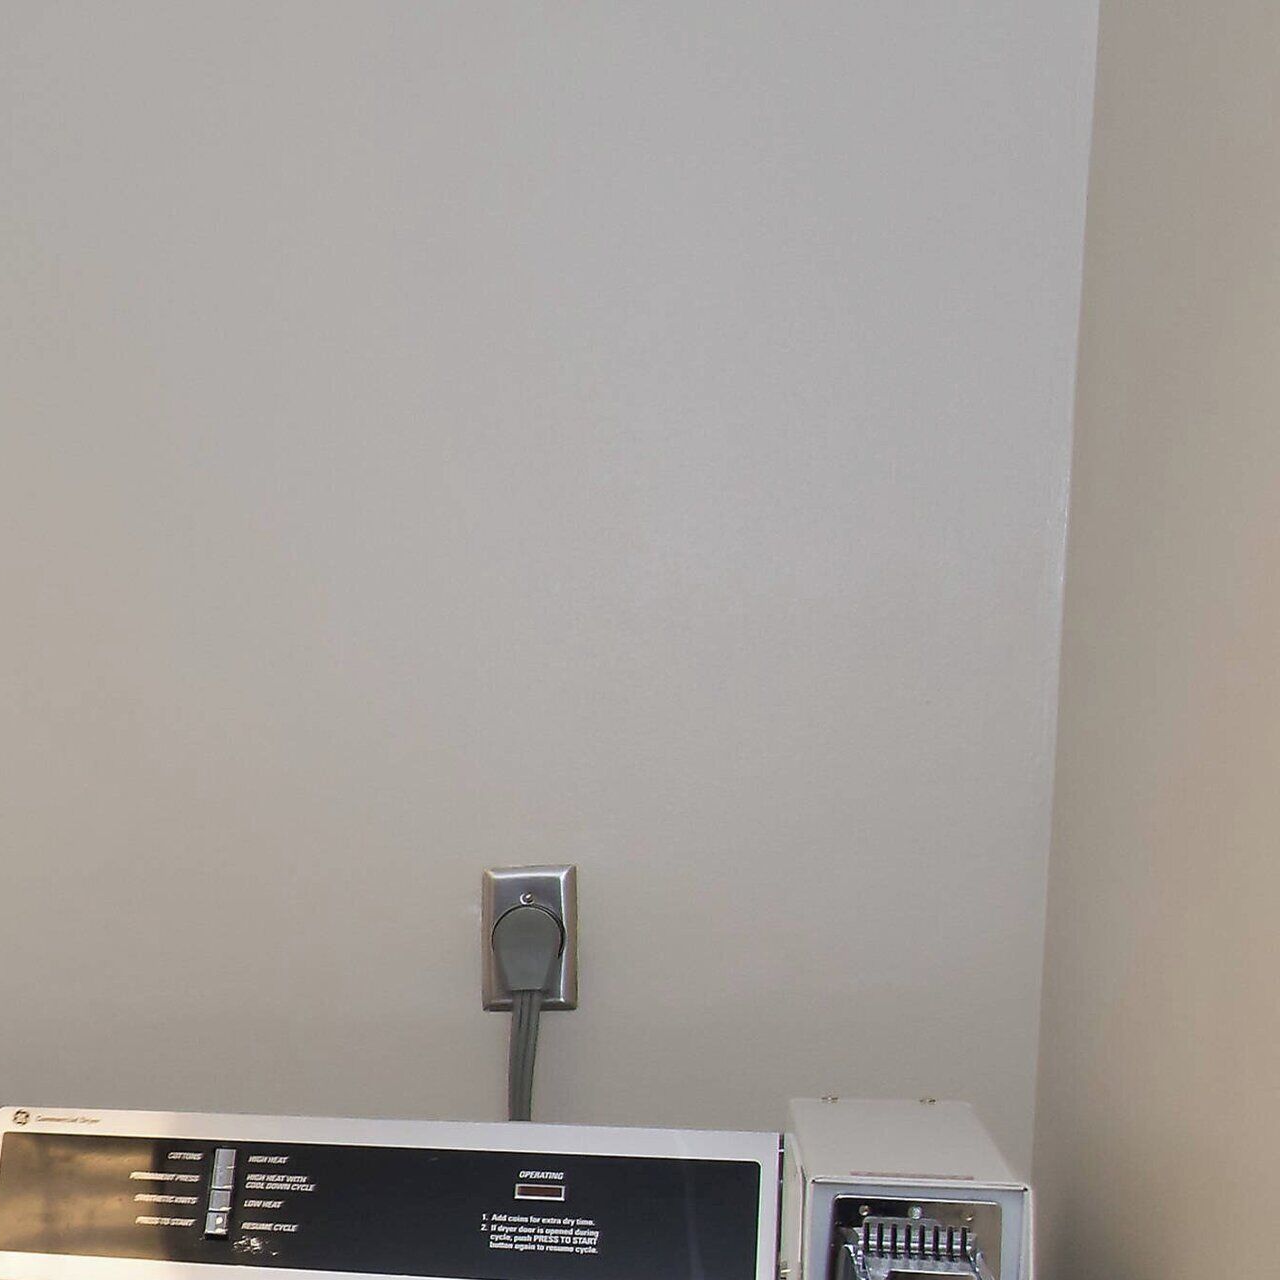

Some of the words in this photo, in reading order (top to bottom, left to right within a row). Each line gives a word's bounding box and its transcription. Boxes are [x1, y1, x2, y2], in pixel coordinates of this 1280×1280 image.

[519, 1171, 564, 1180] OPERATING
[541, 1217, 561, 1225] extra
[562, 1218, 575, 1227] dry
[273, 1224, 299, 1232] CYCLE
[497, 1225, 517, 1234] dryer
[518, 1226, 536, 1234] door
[574, 1228, 599, 1238] during
[490, 1233, 512, 1242] cycle,
[533, 1236, 559, 1244] PRESS
[560, 1236, 571, 1244] TO
[572, 1237, 598, 1245] START
[575, 1246, 598, 1255] cycle.
